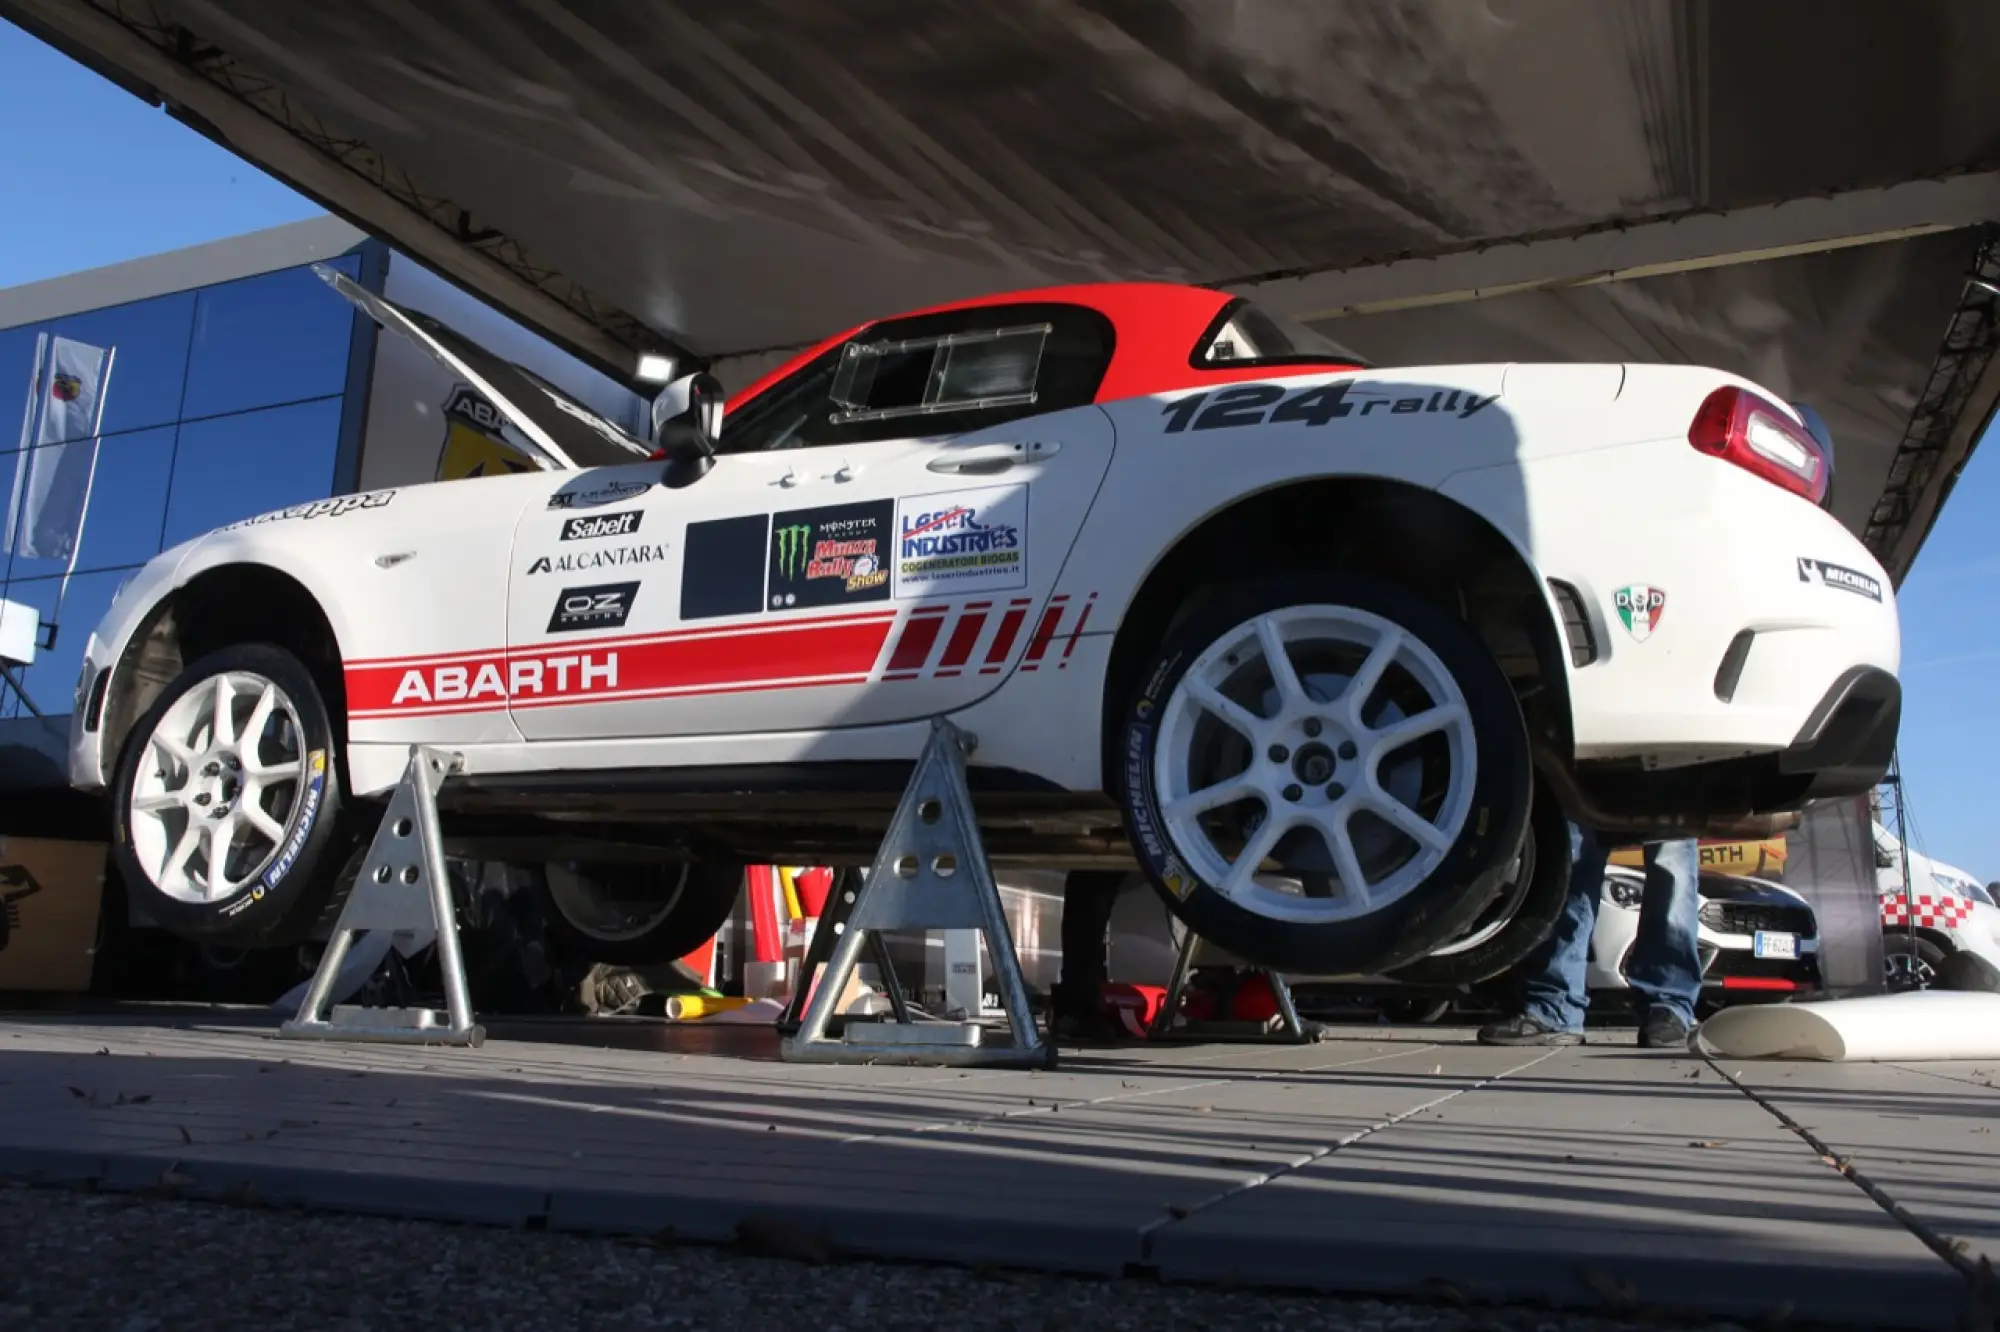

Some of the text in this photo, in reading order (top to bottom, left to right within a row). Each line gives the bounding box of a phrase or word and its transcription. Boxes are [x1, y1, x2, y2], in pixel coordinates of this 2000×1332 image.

[457, 398, 512, 429] ABA
[1161, 378, 1502, 434] 124 rally
[568, 513, 635, 539] Sabelt
[819, 518, 876, 533] MONSTER
[902, 507, 982, 538] LASER
[554, 543, 665, 573] ALCANTARA
[902, 526, 1018, 559] INDUSTRIES
[1826, 566, 1880, 596] MICHELIN
[392, 652, 618, 704] ABARTH
[1128, 728, 1162, 858] MICHELIN
[268, 788, 320, 885] MICHELIN
[1700, 846, 1744, 865] RTH
